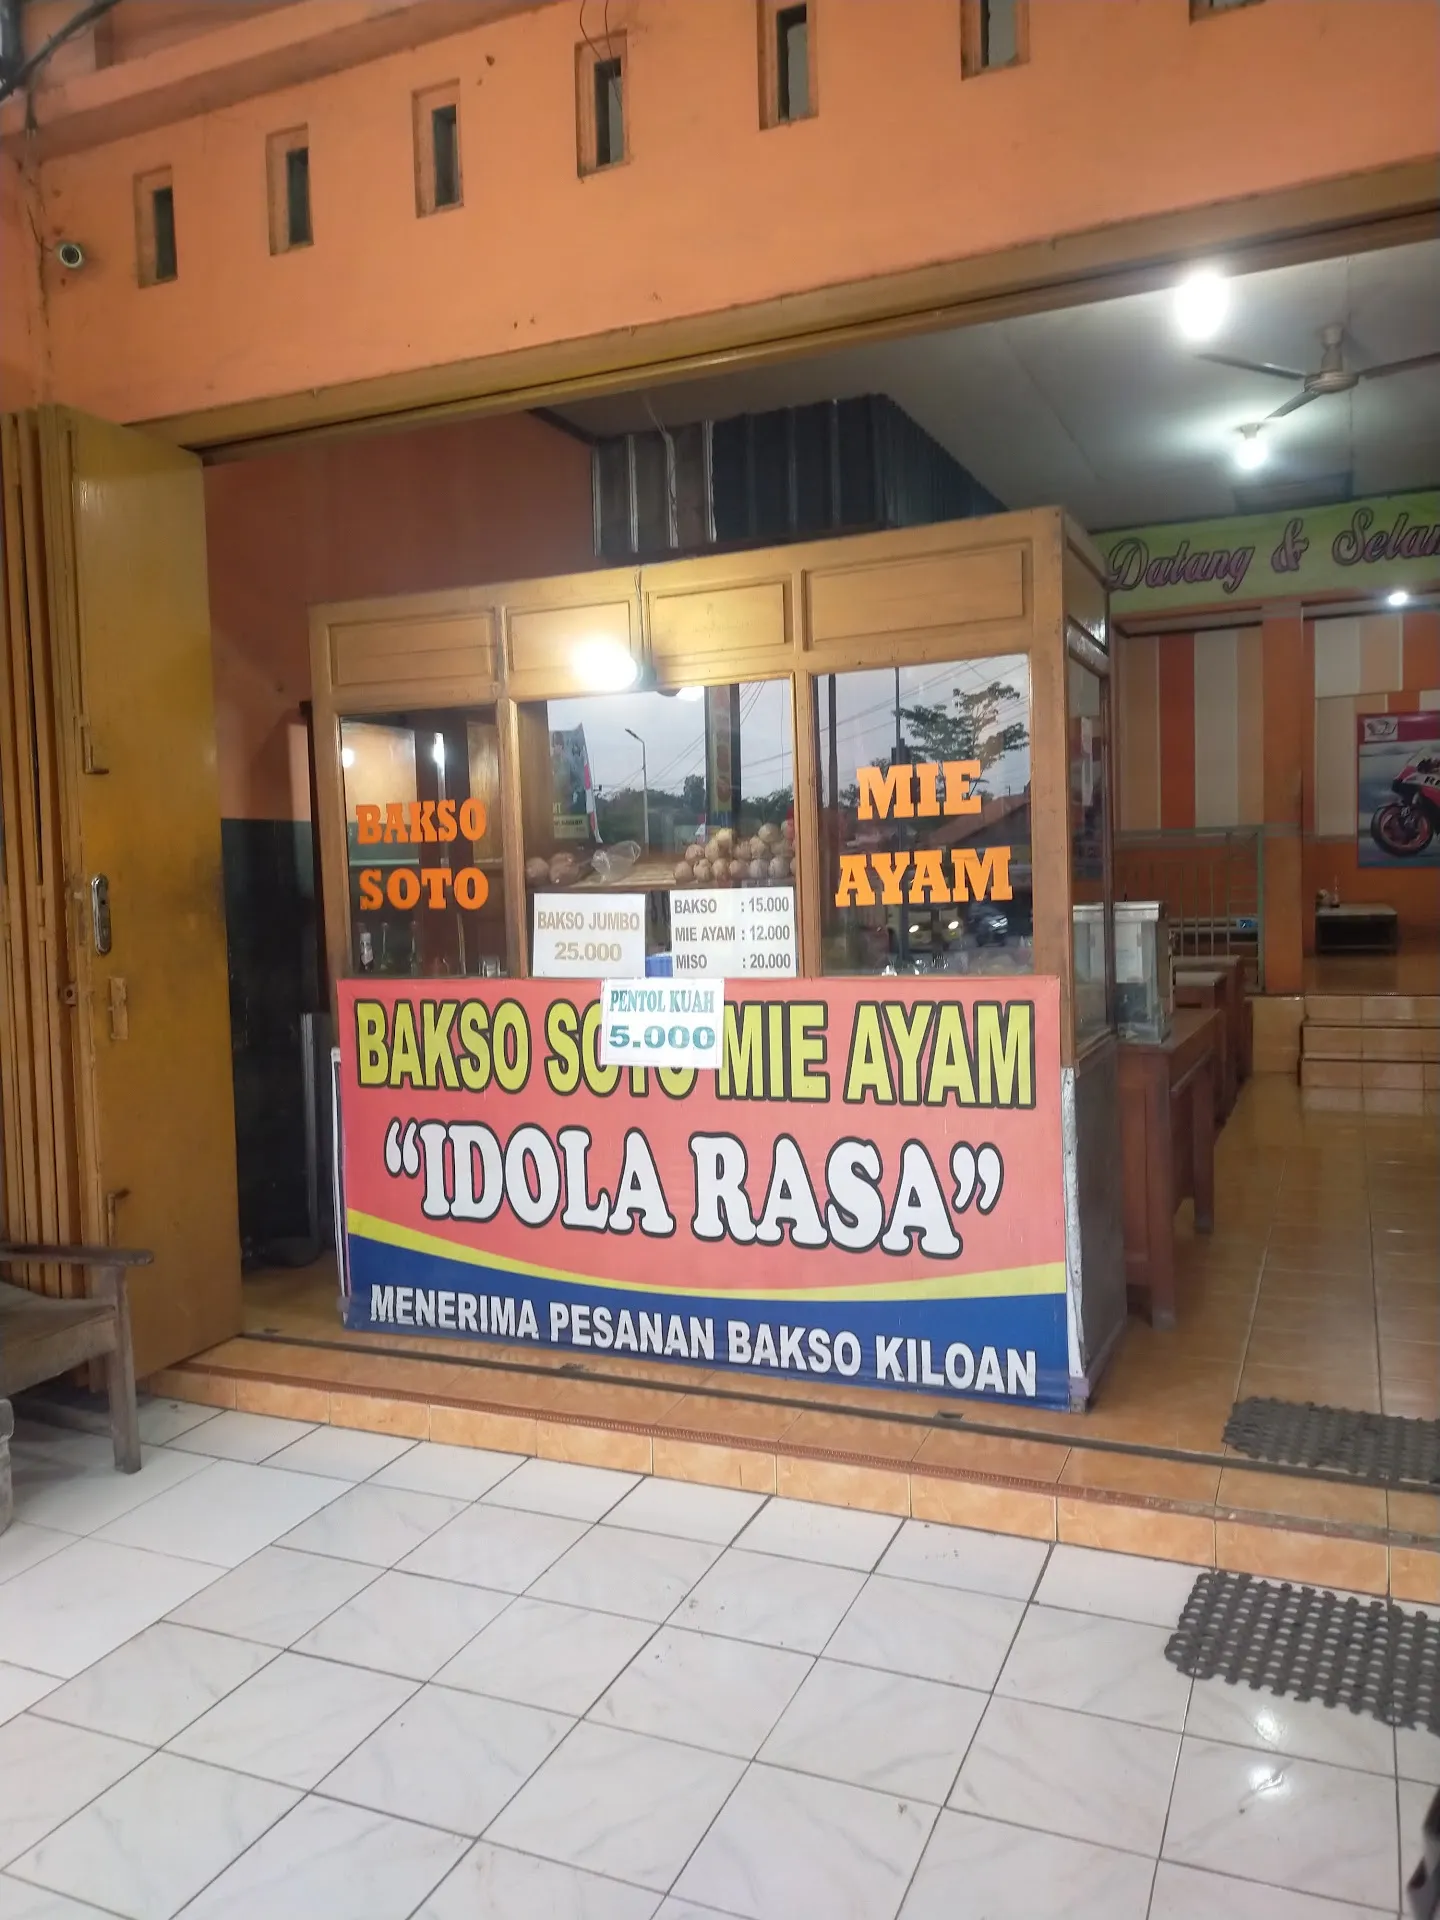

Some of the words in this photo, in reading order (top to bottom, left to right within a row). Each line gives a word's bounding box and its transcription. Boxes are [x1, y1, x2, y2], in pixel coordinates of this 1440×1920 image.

[1105, 537, 1255, 593] Datang
[1270, 517, 1309, 573] &
[857, 760, 982, 820] MIE
[357, 798, 487, 843] BAKSO
[360, 868, 489, 910] SOTO
[834, 846, 1013, 908] AYAM
[537, 912, 584, 930] BAKSO
[588, 913, 640, 931] JUMBO
[674, 899, 717, 914] BAKSO
[554, 942, 622, 962] 25.000
[675, 926, 698, 941] MIE
[701, 926, 736, 941] AYAM
[676, 954, 707, 969] MISO
[609, 989, 666, 1013] PENTOL
[669, 990, 715, 1014] KUAH
[355, 997, 531, 1094] BAKSO
[715, 999, 830, 1103] MIE
[843, 999, 1037, 1109] AYAM
[608, 1025, 716, 1050] 5.000
[384, 1117, 676, 1238] “IDOLA
[689, 1132, 1004, 1259] RASA”
[369, 1284, 539, 1340] MENERIMA
[549, 1301, 714, 1361] PESANAN
[727, 1320, 862, 1377] BAKSO
[875, 1333, 1038, 1398] KILOAN
